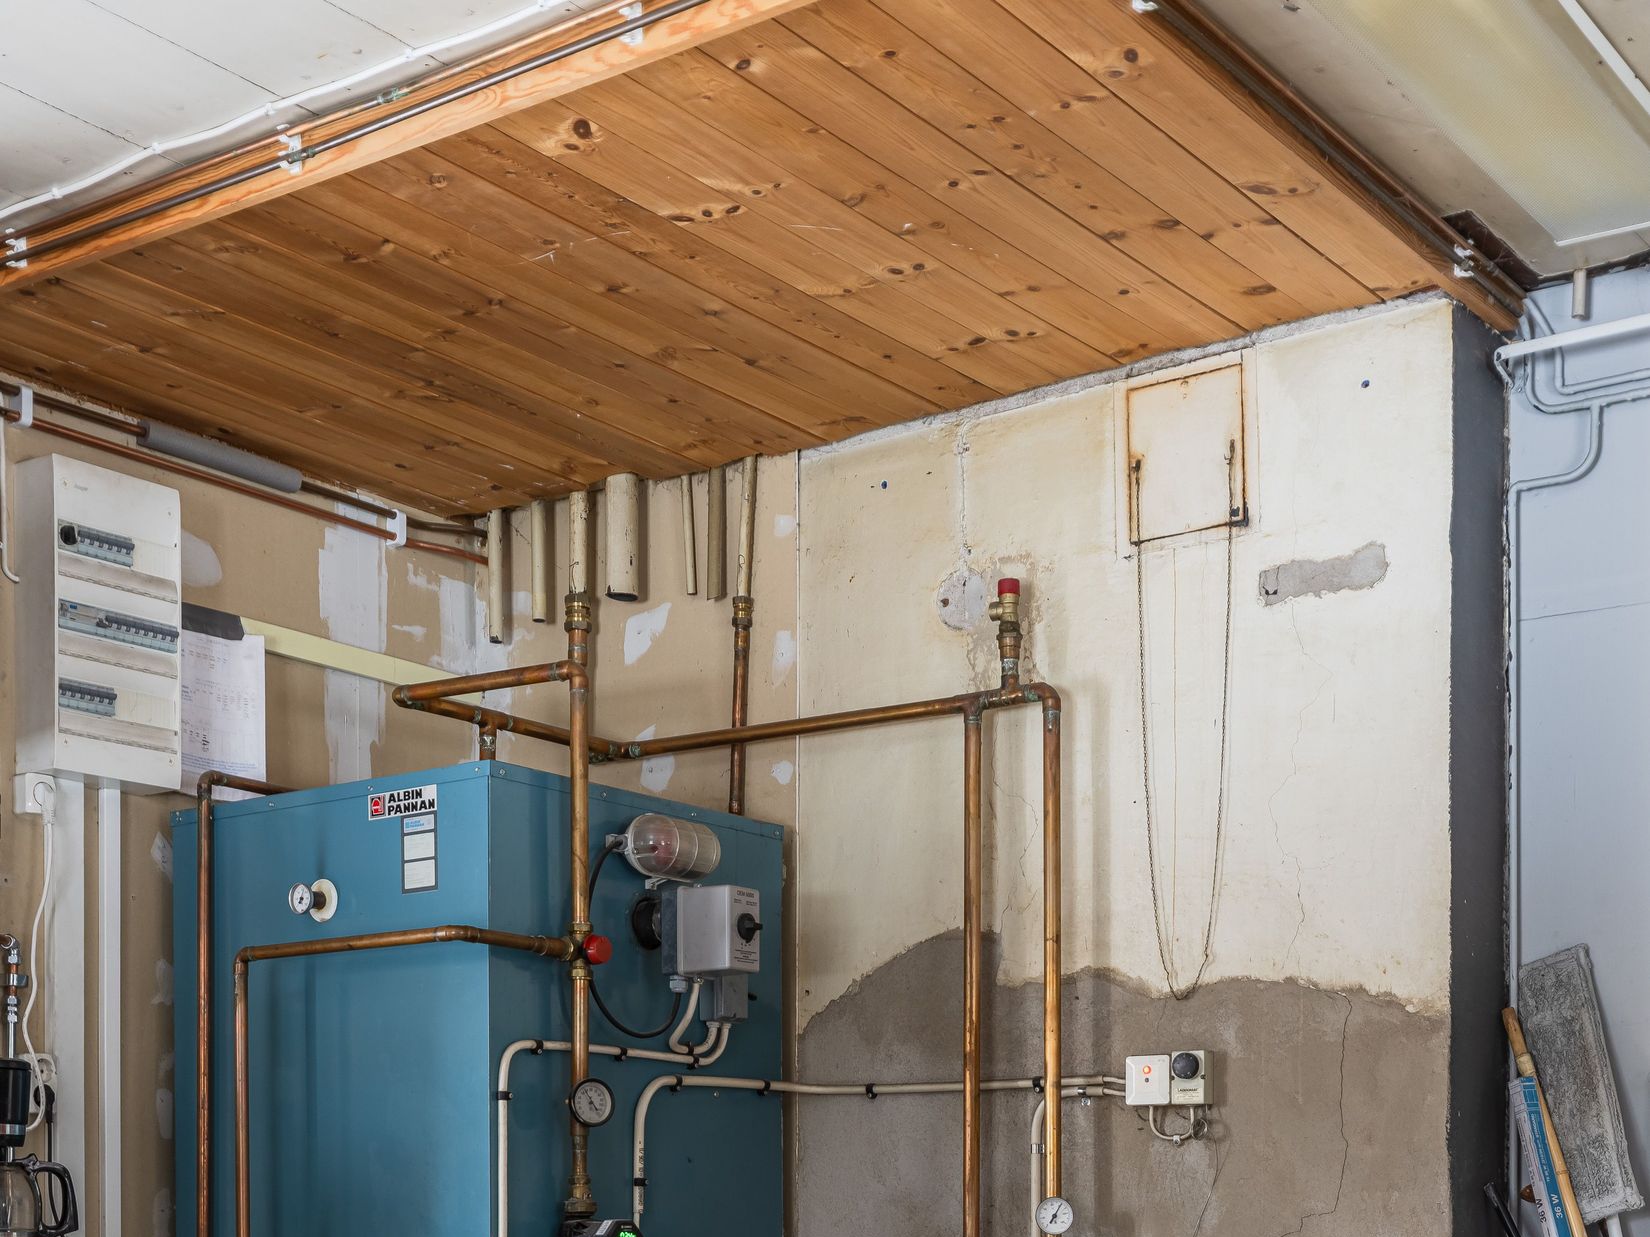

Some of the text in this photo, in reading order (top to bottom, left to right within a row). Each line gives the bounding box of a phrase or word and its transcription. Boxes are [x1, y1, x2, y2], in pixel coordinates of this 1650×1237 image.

[388, 789, 423, 804] ALBIN
[387, 799, 436, 817] PANNAN
[1535, 1198, 1547, 1224] 36 W
[1550, 1193, 1563, 1218] 36 W
